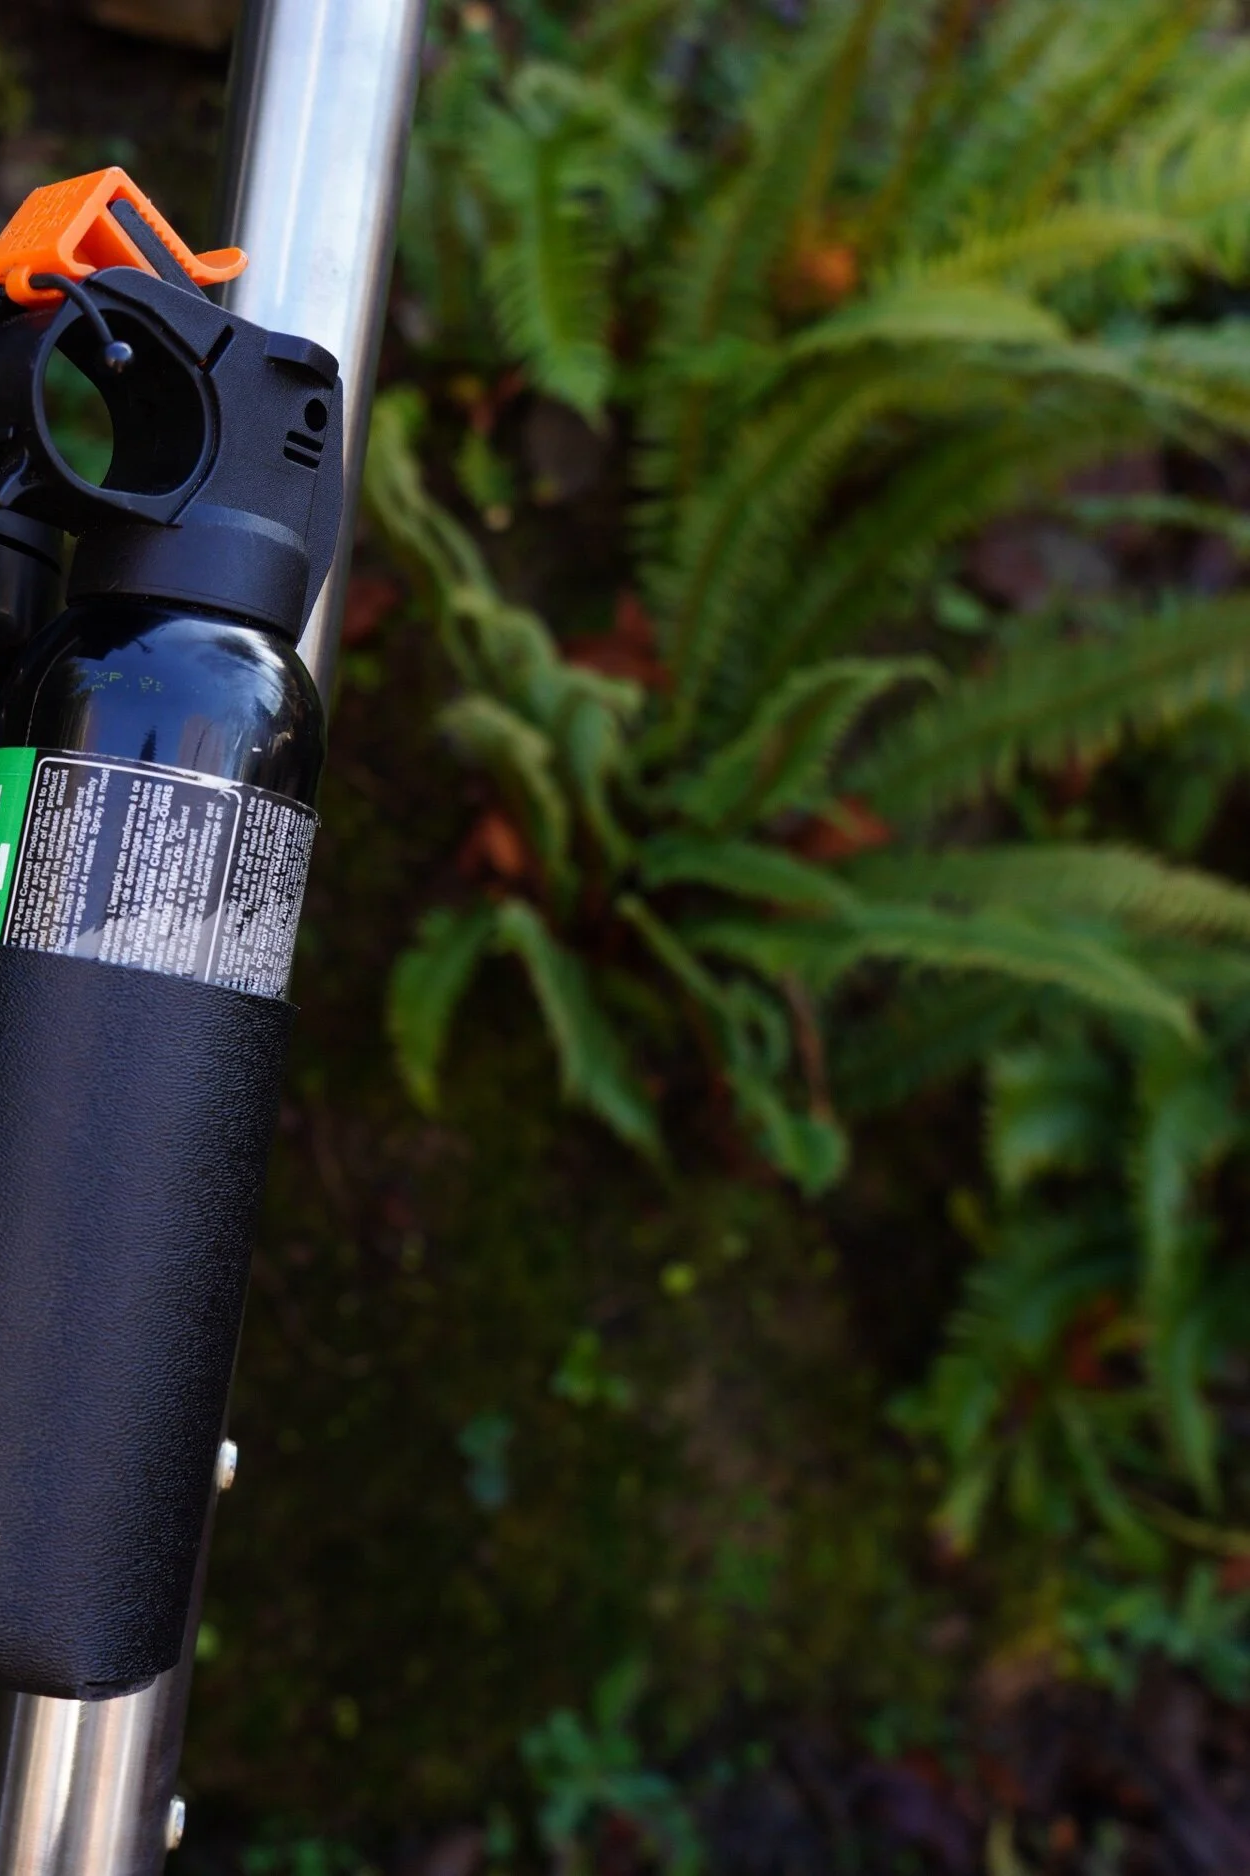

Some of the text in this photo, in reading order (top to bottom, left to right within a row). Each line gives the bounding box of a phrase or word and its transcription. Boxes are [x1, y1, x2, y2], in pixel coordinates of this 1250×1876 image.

[41, 766, 50, 785] use
[97, 768, 110, 793] most
[38, 786, 47, 797] to
[55, 768, 69, 805] amount
[131, 779, 141, 793] ce
[35, 797, 44, 815] Act
[70, 785, 87, 823] against
[94, 793, 105, 804] is
[246, 795, 256, 812] the
[204, 801, 215, 817] est
[214, 806, 224, 819] en
[88, 804, 105, 835] Spray
[118, 802, 136, 849] conforme
[135, 810, 146, 829] aux
[244, 814, 253, 827] on
[26, 815, 41, 859] Products
[65, 823, 78, 848] used
[207, 820, 223, 856] orange
[242, 828, 250, 840] or
[273, 807, 291, 873] PASSENGER
[21, 768, 60, 930] from any such use of this product.
[63, 849, 73, 863] be
[123, 830, 145, 886] dommages
[156, 871, 168, 891] des
[164, 817, 178, 843] Pour
[237, 842, 249, 867] eyes
[40, 806, 71, 927] to be used in wilderness
[40, 860, 51, 877] the
[54, 775, 99, 954] Place thumb in front of orange safety
[61, 863, 70, 874] to
[116, 850, 127, 870] non
[131, 861, 147, 902] vendeur
[145, 822, 155, 836] un
[244, 854, 253, 871] not
[253, 857, 261, 871] no
[19, 860, 32, 896] Control
[79, 874, 89, 883] 4
[130, 783, 174, 963] YUKON MAGNUM CHASSE-OURS
[158, 901, 173, 936] MODE
[175, 804, 190, 839] Quand
[232, 867, 242, 884] the
[250, 872, 258, 881] is
[38, 877, 47, 889] of
[58, 875, 68, 892] not
[77, 882, 87, 894] of
[240, 873, 250, 890] will
[271, 875, 278, 887] IN
[106, 871, 124, 914] L'emploi
[120, 886, 131, 901] de
[176, 889, 186, 904] en
[230, 886, 239, 896] in
[14, 897, 25, 921] Pest
[30, 890, 45, 930] address
[72, 895, 87, 925] range
[118, 902, 128, 916] ou
[195, 897, 206, 912] de
[264, 888, 276, 925] STORE
[223, 898, 238, 934] directly
[11, 922, 20, 938] the
[47, 923, 60, 945] only
[259, 926, 269, 950] NOT
[256, 951, 264, 968] DO
